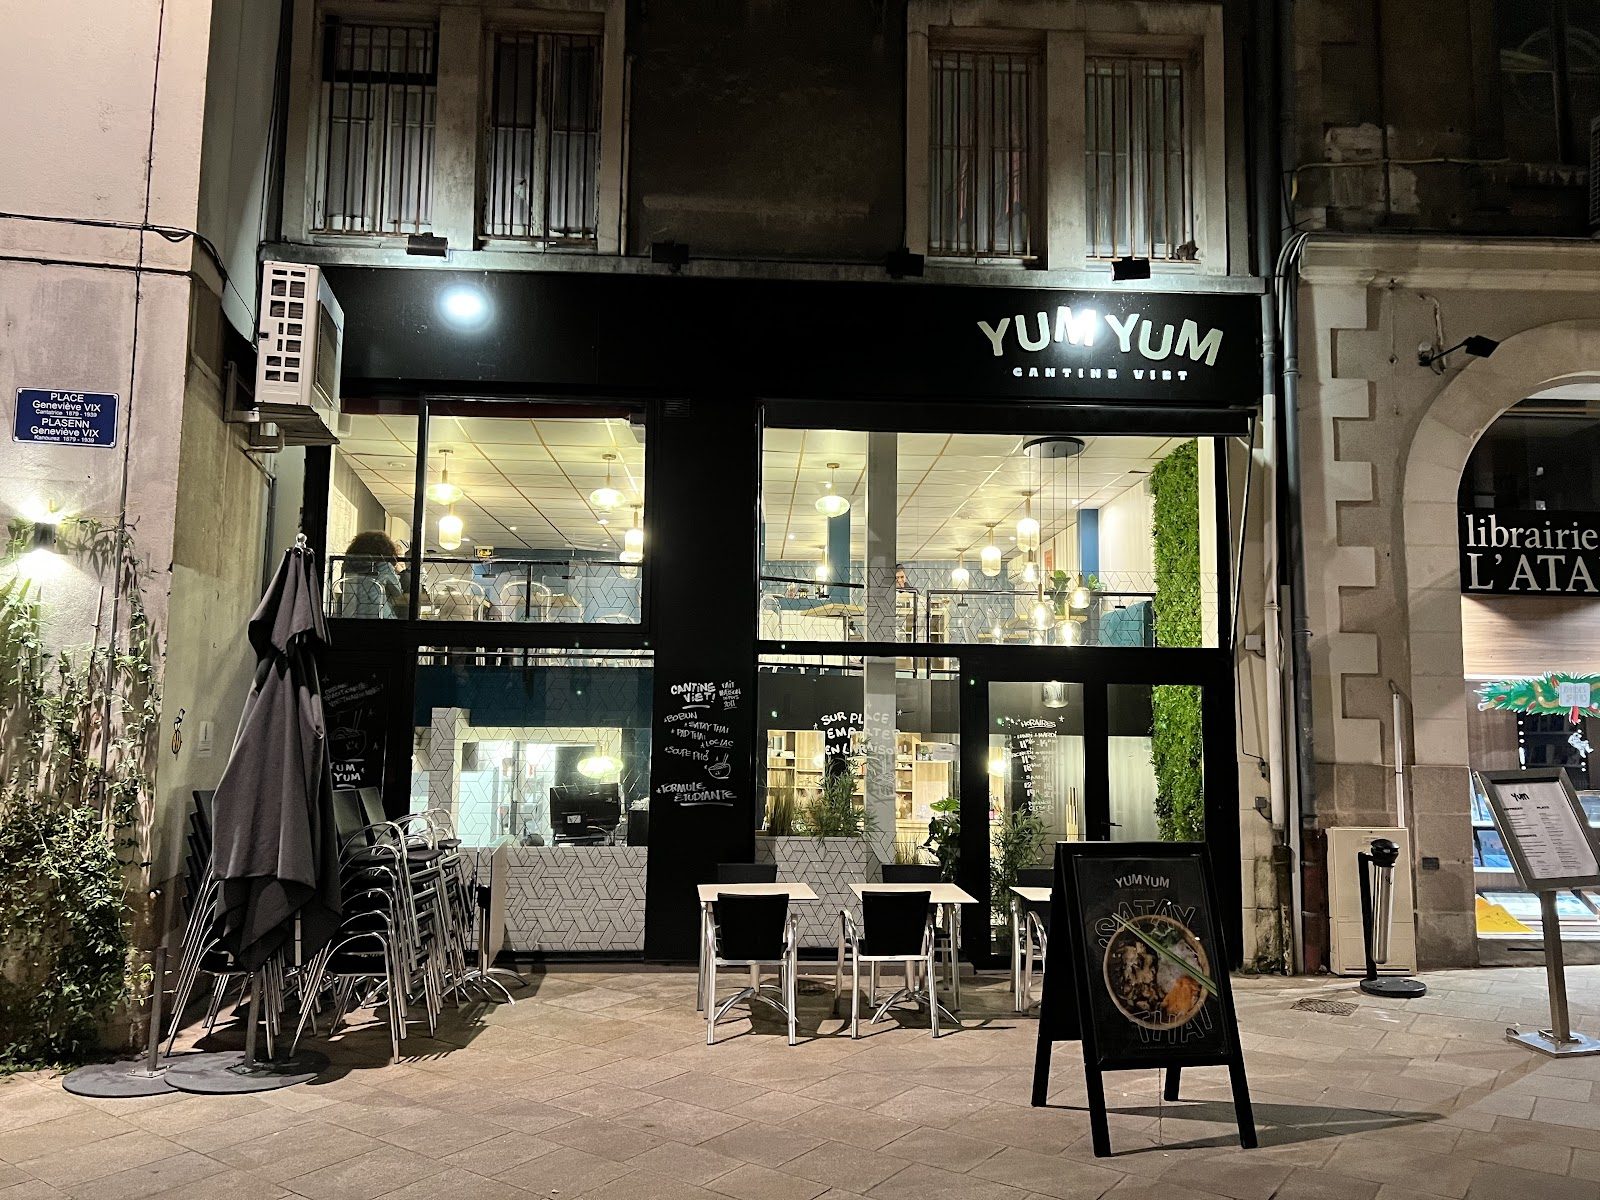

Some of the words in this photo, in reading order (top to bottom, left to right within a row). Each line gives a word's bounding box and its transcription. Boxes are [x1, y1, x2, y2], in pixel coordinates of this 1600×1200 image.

[977, 306, 1097, 356] YUM
[1104, 313, 1223, 367] YUM
[1012, 367, 1118, 379] CANTINE
[1133, 369, 1188, 381] VIET
[50, 393, 84, 402] PLACE
[32, 400, 81, 411] Geneviève
[83, 403, 101, 412] VIX
[41, 418, 90, 429] PLASENN
[30, 426, 80, 437] Geneviève
[82, 429, 99, 438] VIX
[1465, 514, 1598, 550] librairie
[1466, 552, 1600, 592] L'ATA
[670, 682, 716, 695] CANTINE
[821, 712, 848, 725] SUR
[688, 721, 712, 731] SATAY
[713, 723, 729, 734] THAI
[827, 727, 901, 740] EMPRTER
[691, 730, 706, 740] THAI
[668, 746, 692, 757] SOUPE
[825, 745, 841, 756] EN
[842, 743, 901, 756] LRAISO
[333, 772, 361, 782] YUM
[1115, 874, 1143, 888] YUM
[1143, 876, 1170, 888] YUM
[1095, 898, 1196, 950] SATAY
